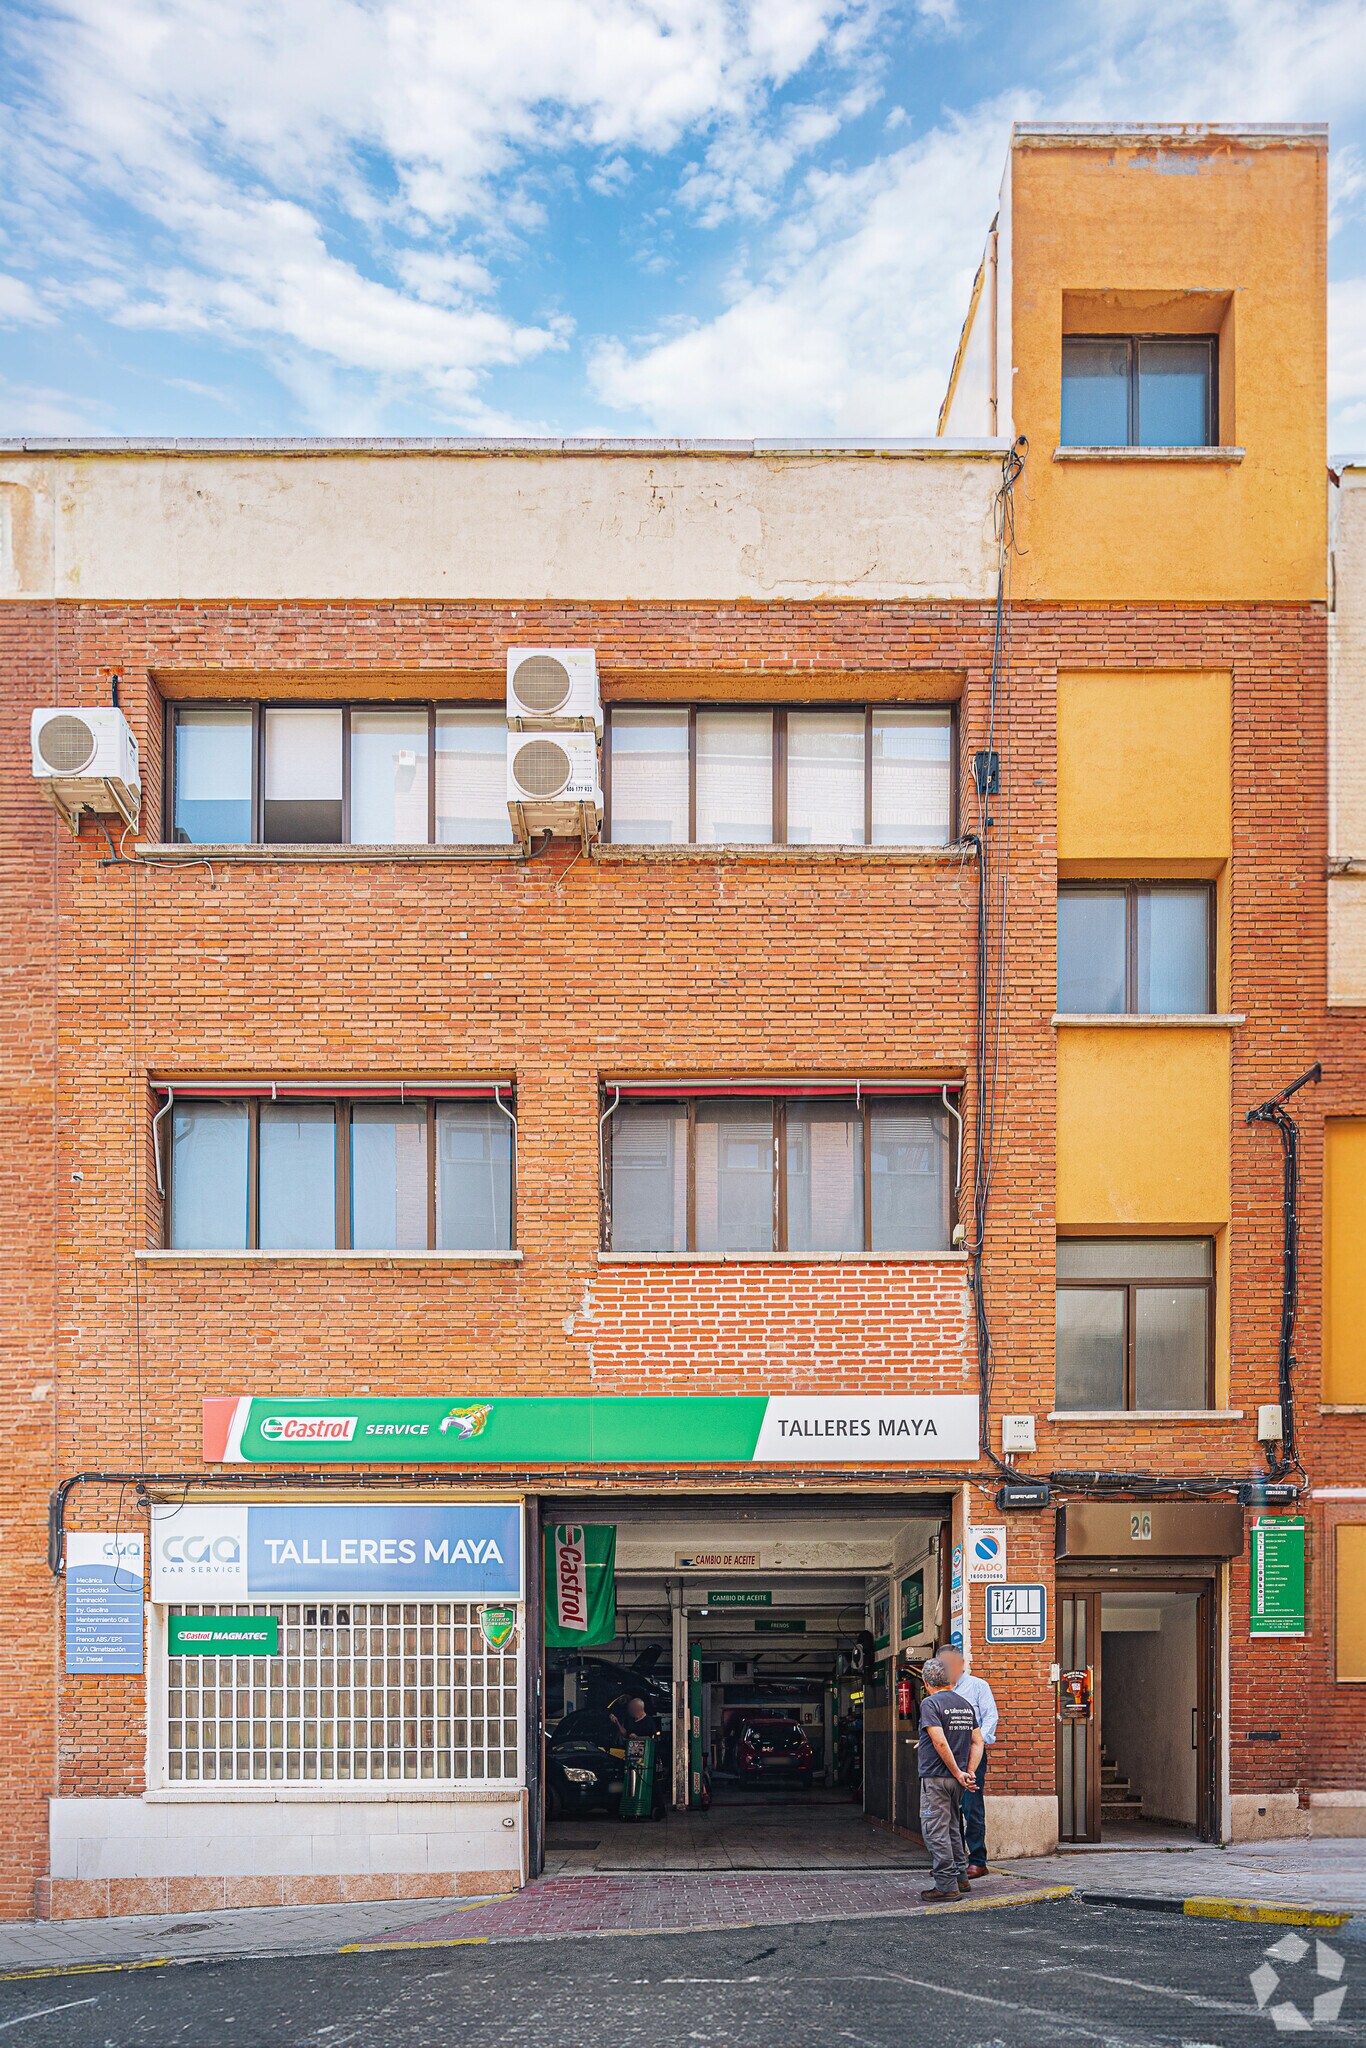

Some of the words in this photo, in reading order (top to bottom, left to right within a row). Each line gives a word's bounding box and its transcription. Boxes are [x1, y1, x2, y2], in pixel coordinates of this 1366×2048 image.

[284, 1419, 349, 1438] Castrol
[365, 1424, 430, 1435] SERVICE
[778, 1419, 871, 1437] TALLERES
[878, 1419, 938, 1436] MAYA
[1131, 1515, 1150, 1538] 26
[264, 1539, 416, 1564] TALLERES
[424, 1539, 504, 1564] MAYA
[695, 1555, 721, 1565] CAMBIO
[723, 1555, 732, 1565] DE
[734, 1555, 755, 1565] ACEITE
[971, 1562, 1002, 1572] VADO
[559, 1547, 584, 1623] Castrol
[185, 1632, 210, 1640] Castrol
[213, 1632, 268, 1640] MAGNATEC
[1012, 1627, 1037, 1636] 17588
